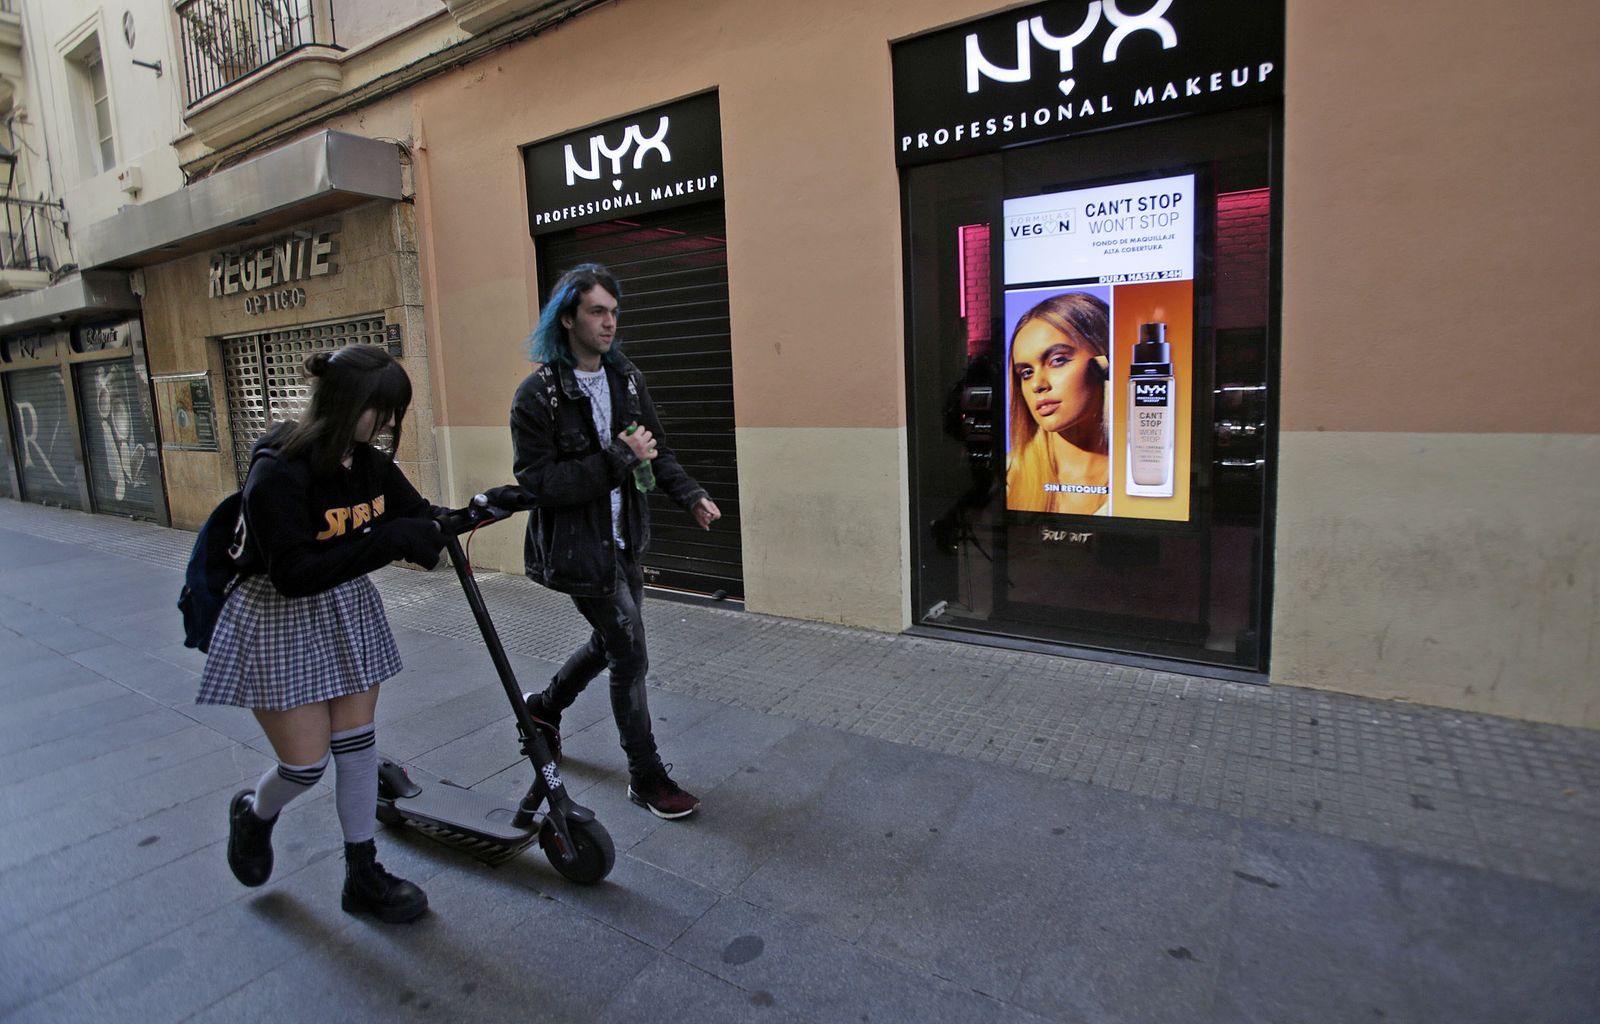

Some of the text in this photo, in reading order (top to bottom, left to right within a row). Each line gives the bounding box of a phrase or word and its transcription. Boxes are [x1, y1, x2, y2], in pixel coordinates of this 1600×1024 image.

[965, 0, 1178, 94] NYX
[902, 62, 1274, 151] PROFESSIONAL MAKEUP
[564, 116, 672, 185] NYX
[536, 175, 718, 225] PROFESSIONAL MAKEUP
[1085, 192, 1183, 217] CAN'T STOP
[1088, 211, 1180, 234] WON'T STOP
[1121, 244, 1163, 253] COBERTURA
[1129, 234, 1175, 243] MAQUILLAJE
[208, 230, 335, 298] REGENTE
[1099, 269, 1183, 284] DURA HASTA 24H
[245, 287, 304, 315] OPTICO
[1136, 384, 1166, 395] NYX
[1139, 412, 1163, 420] CAN'T
[1140, 420, 1162, 428] STOP
[1044, 483, 1108, 494] SIN RETOQUES
